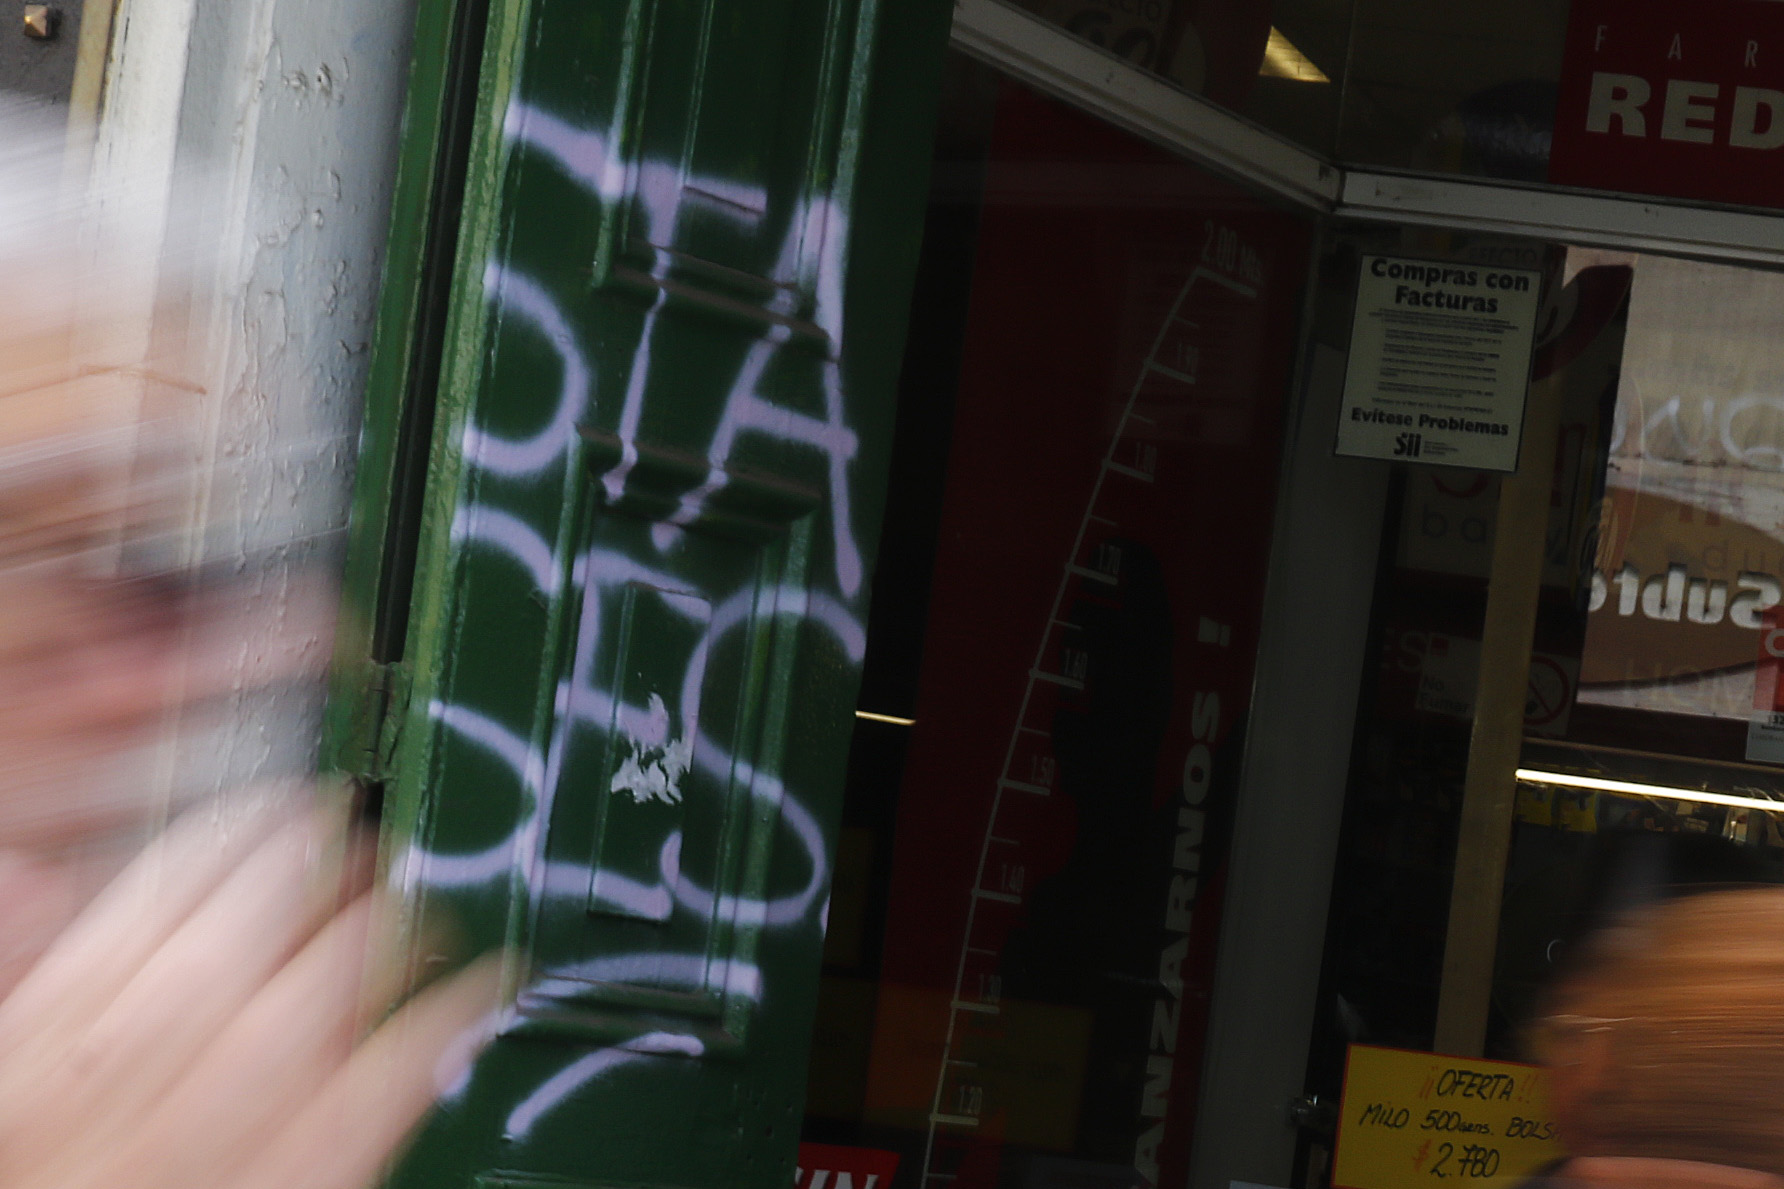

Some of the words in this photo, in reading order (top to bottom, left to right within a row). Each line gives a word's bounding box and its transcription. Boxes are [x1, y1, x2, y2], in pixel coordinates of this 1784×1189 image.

[1371, 258, 1478, 287] Compras
[1486, 272, 1529, 292] con
[1395, 285, 1498, 313] Facturas
[1419, 413, 1509, 436] Problemas
